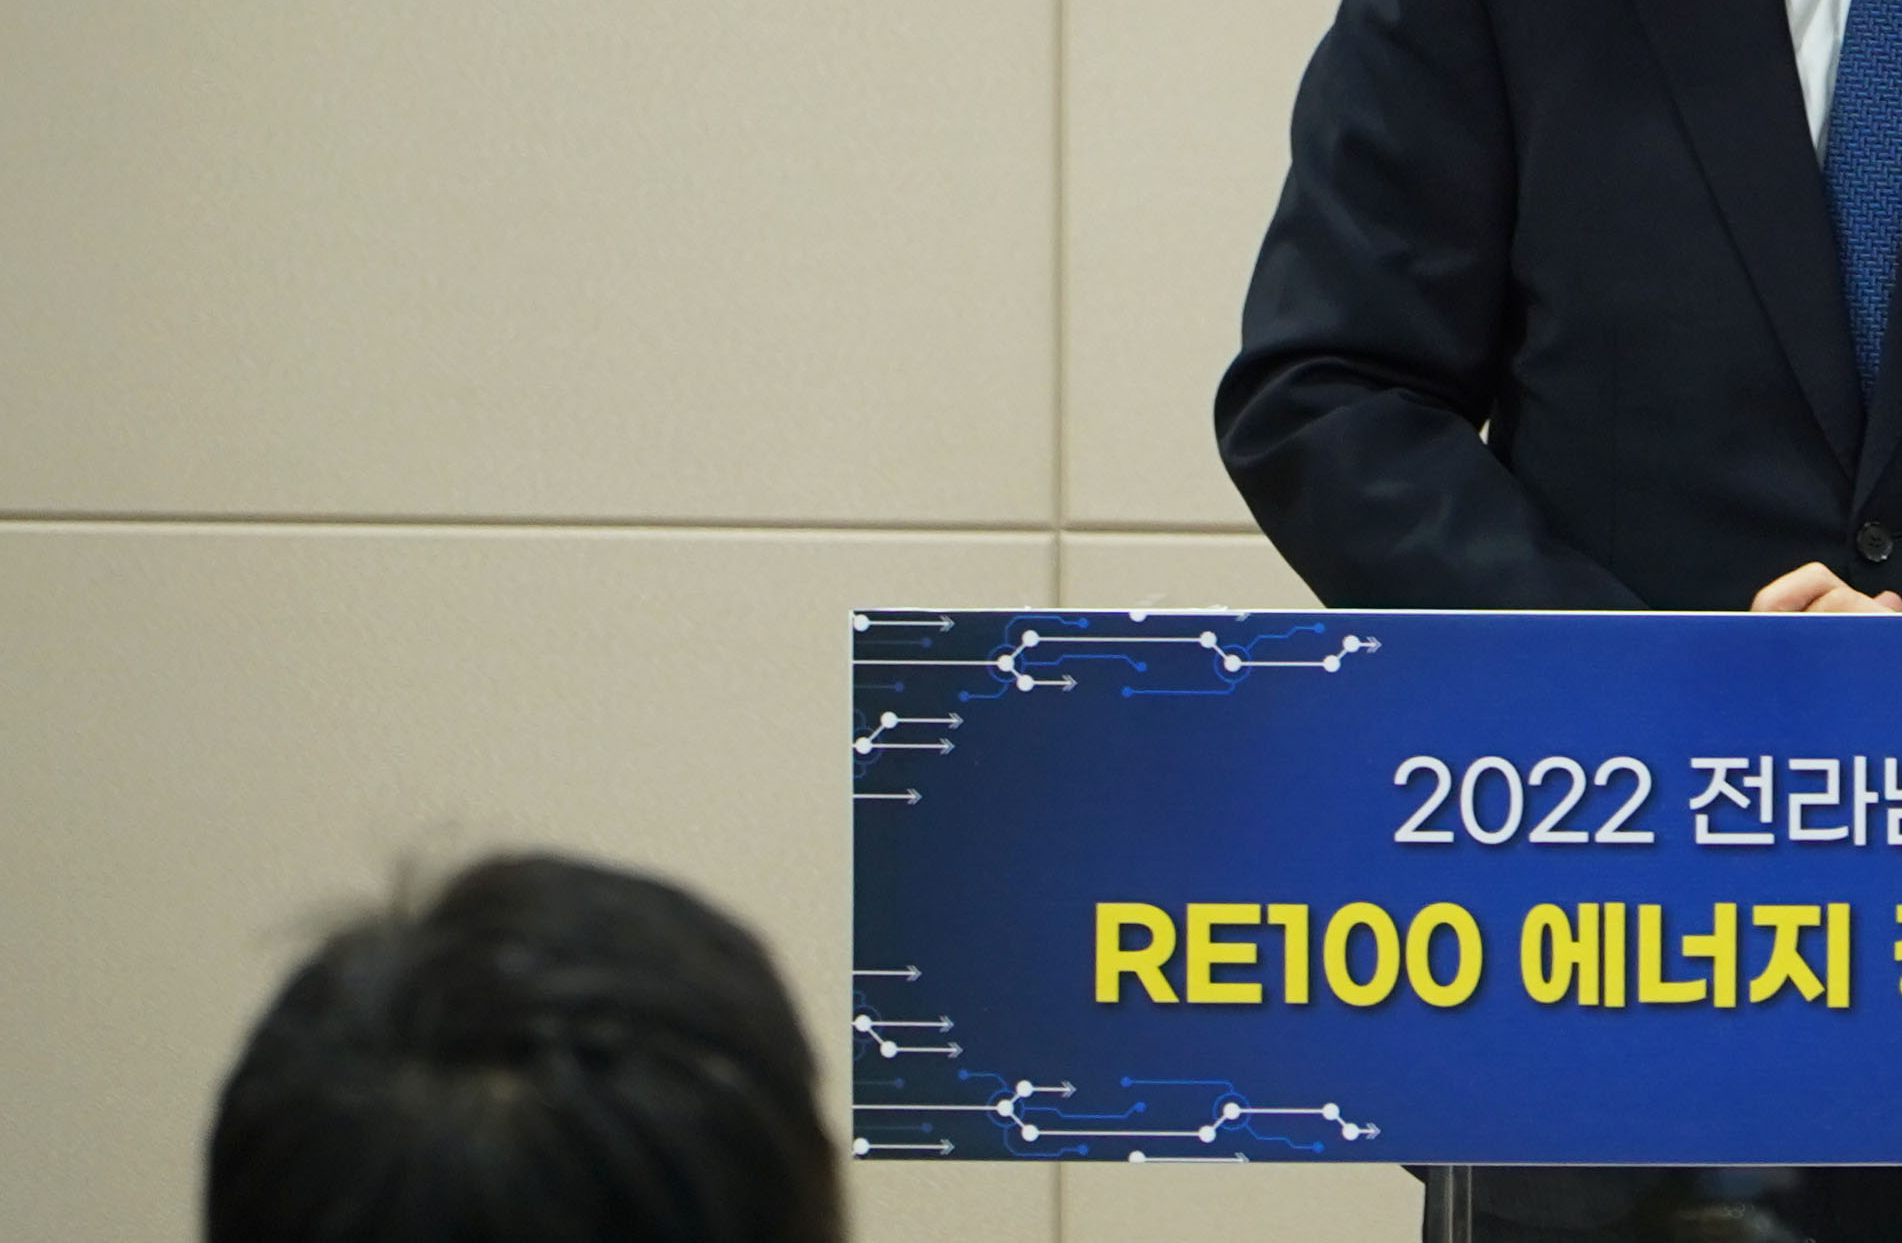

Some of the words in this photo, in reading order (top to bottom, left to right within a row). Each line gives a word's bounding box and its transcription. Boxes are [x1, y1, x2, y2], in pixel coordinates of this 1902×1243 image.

[1394, 756, 1654, 844] 2022
[1096, 902, 1482, 1007] RE100
[1520, 902, 1850, 1008] 에너지
